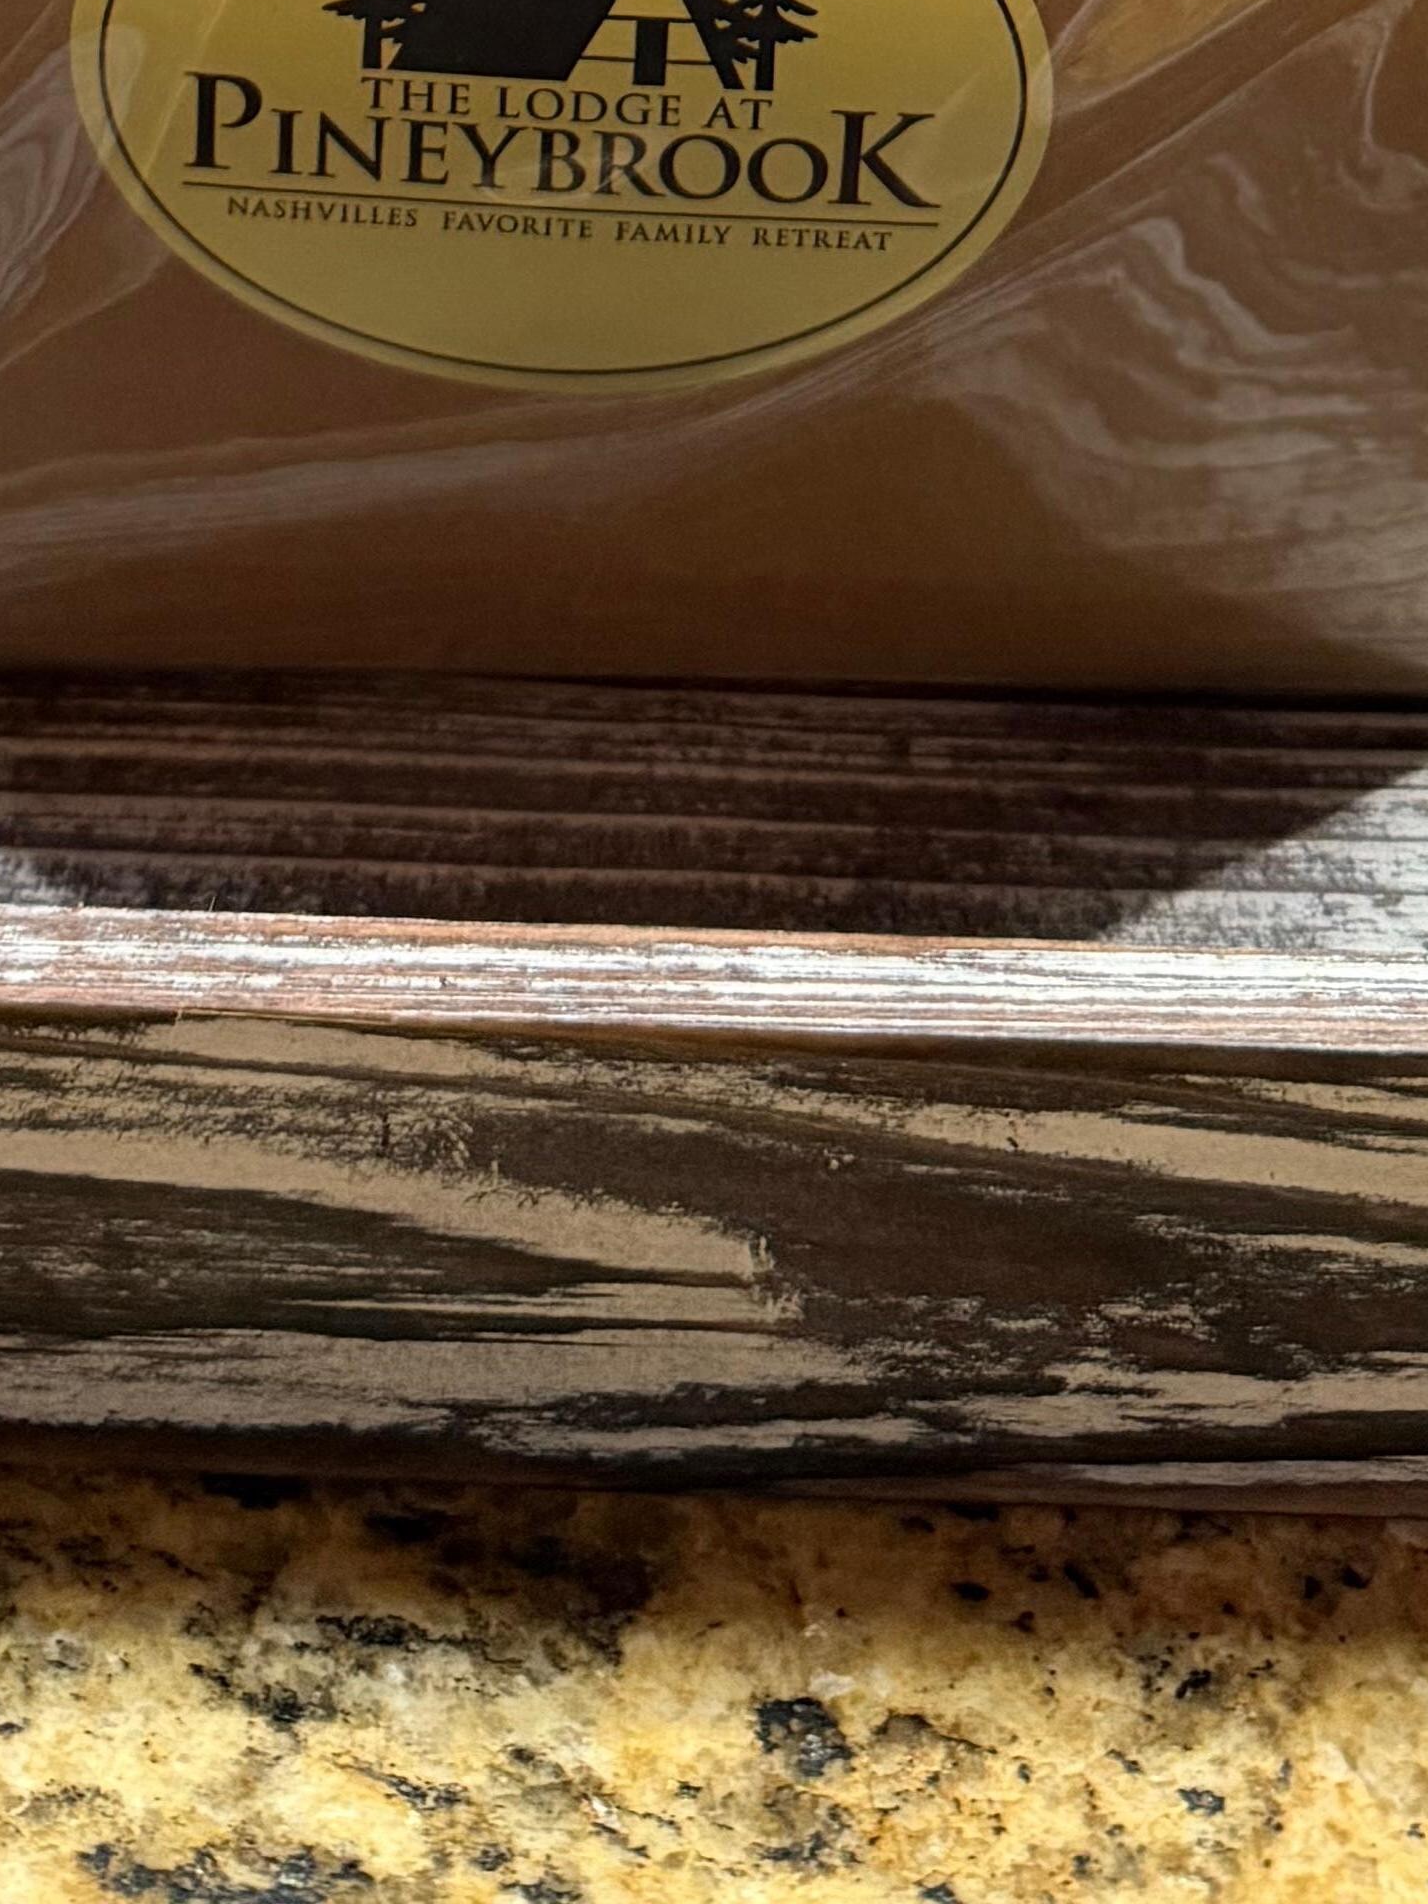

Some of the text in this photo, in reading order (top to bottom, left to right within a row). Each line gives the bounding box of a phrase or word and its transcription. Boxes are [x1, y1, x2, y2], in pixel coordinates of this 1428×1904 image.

[360, 76, 773, 130] THE LODGE AT
[227, 195, 893, 252] NASHVILLES FAVORITE FAMILY RETREAT
